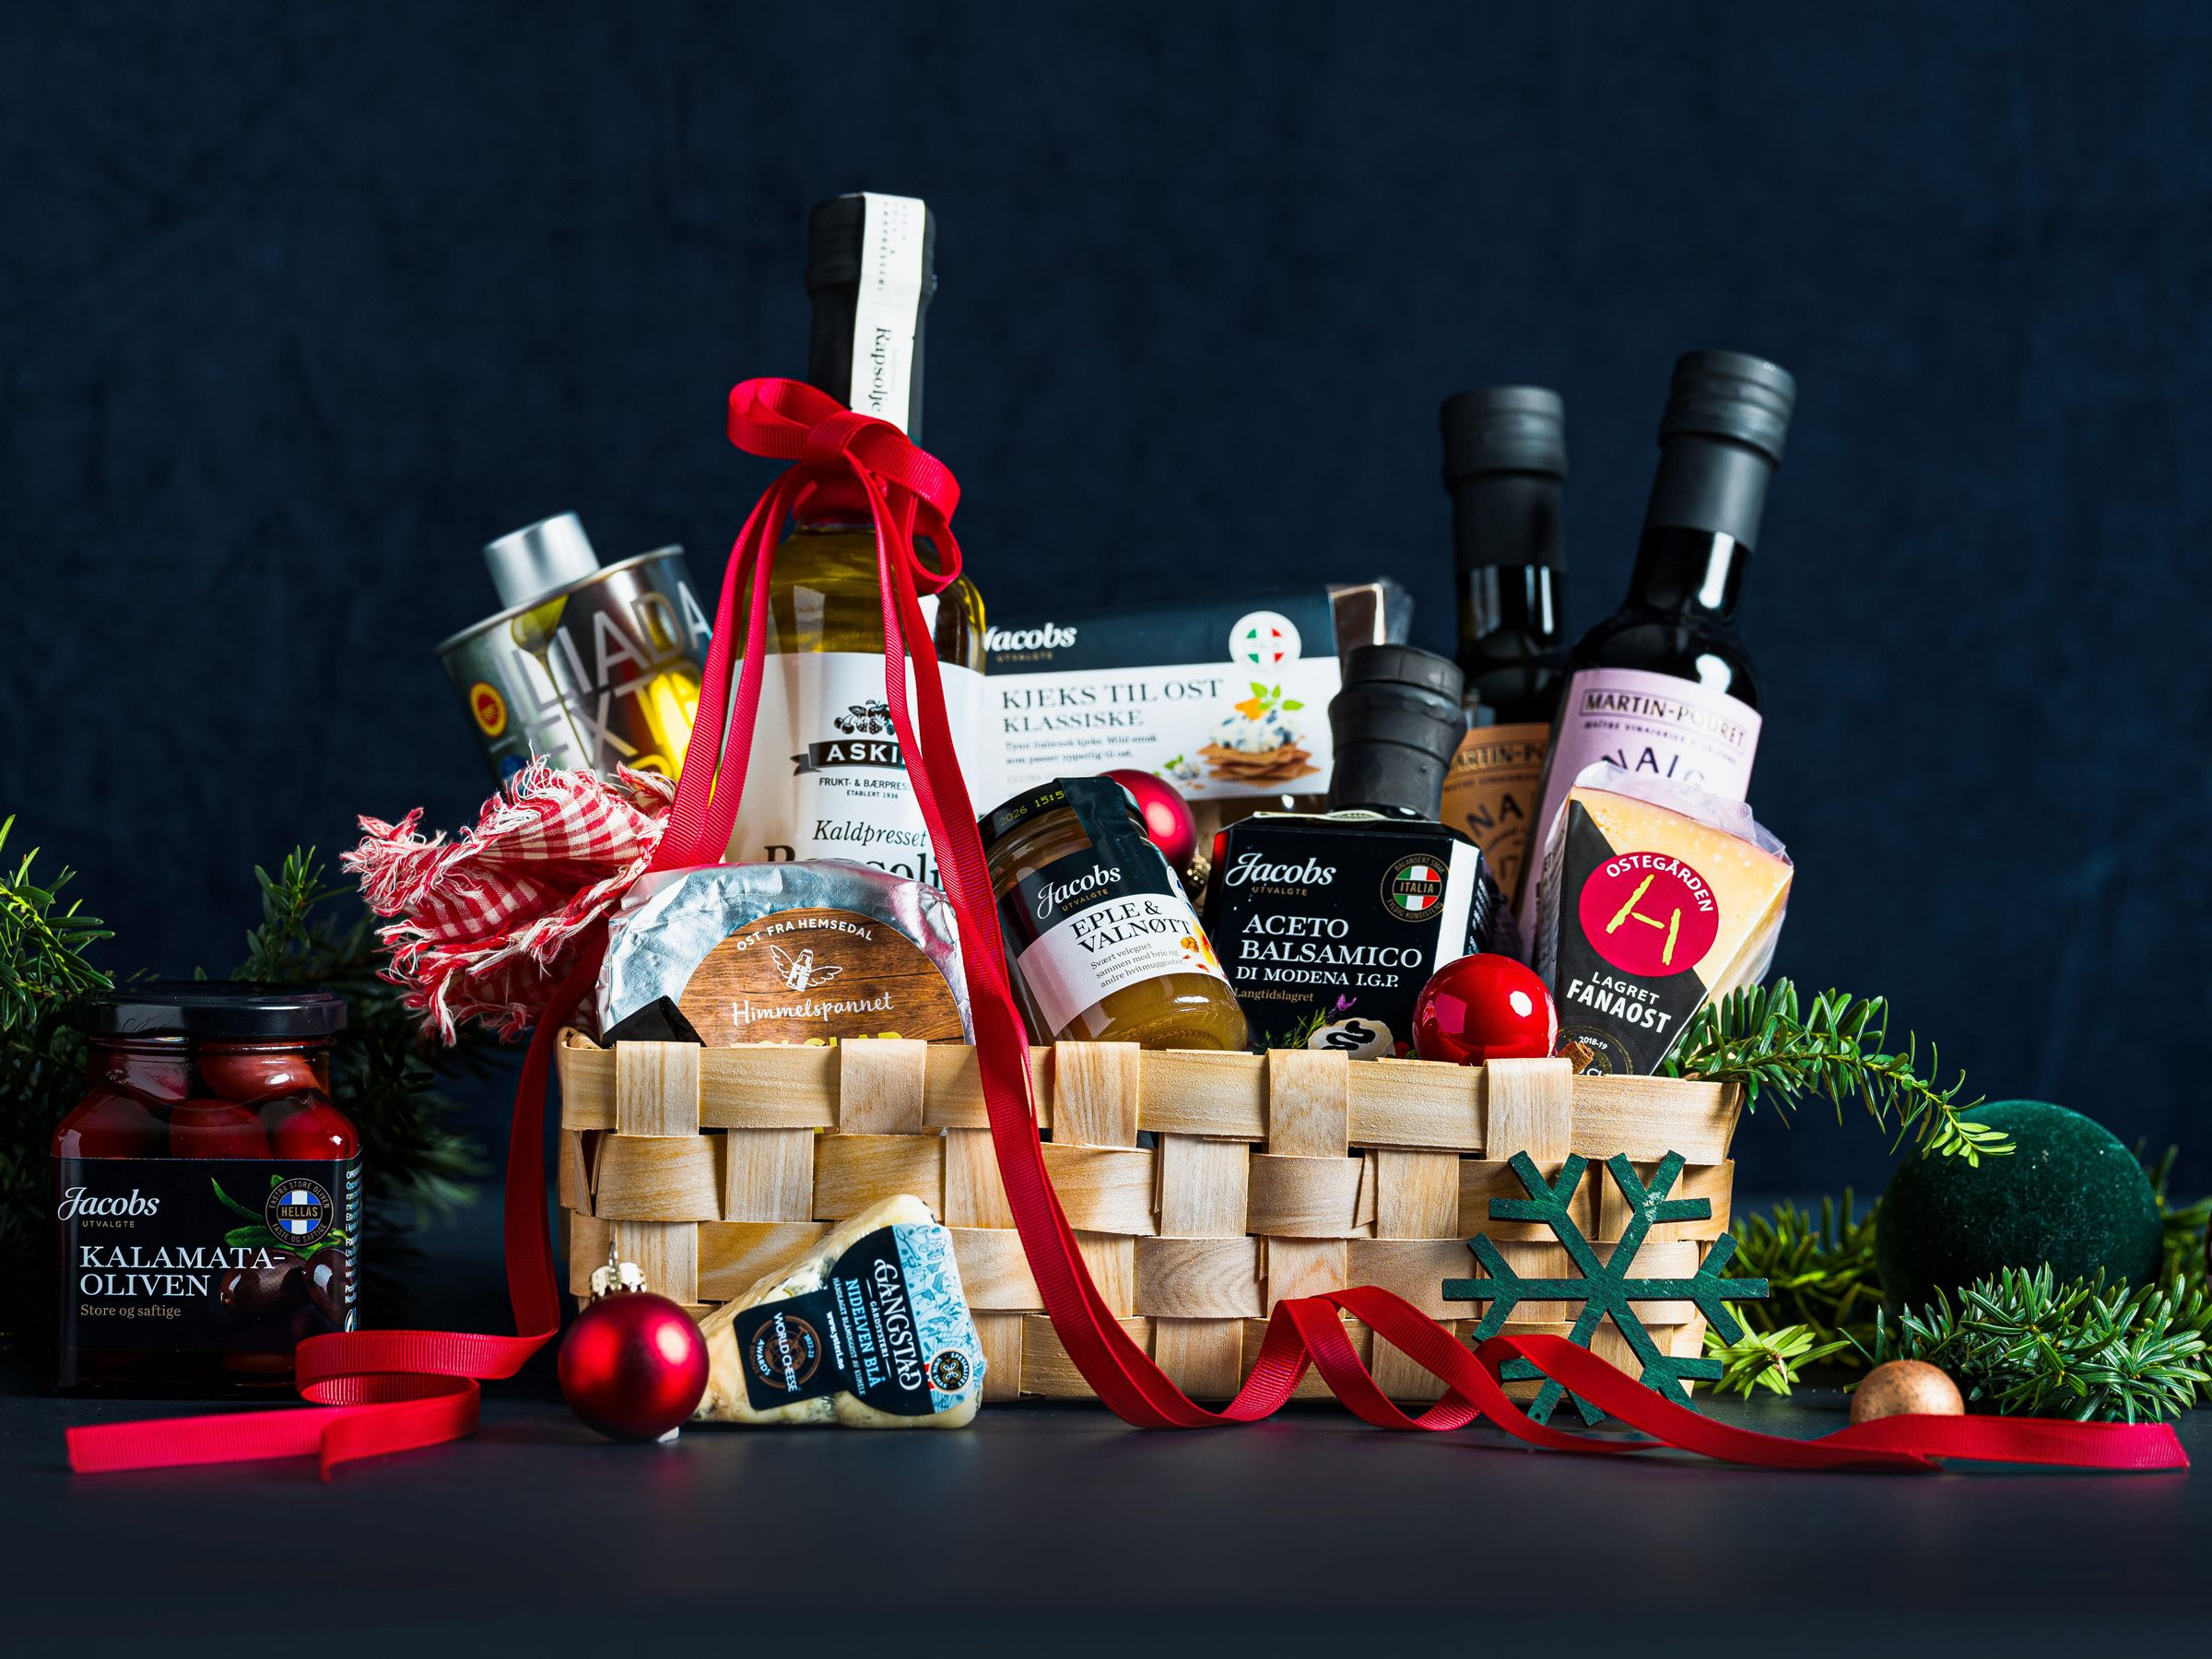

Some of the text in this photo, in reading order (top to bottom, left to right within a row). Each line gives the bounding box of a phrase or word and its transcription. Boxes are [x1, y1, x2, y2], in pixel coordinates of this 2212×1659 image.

[1002, 678, 1225, 711] KJEKS TIL OST
[1003, 710, 1145, 734] KLASSISKE
[826, 743, 906, 765] ASKI
[818, 777, 911, 791] FRUKT- & BÆRPRES
[846, 790, 880, 798] ETABLERT
[1000, 790, 1066, 827] 2026 15:5
[812, 819, 928, 848] Kaldpresset
[1225, 853, 1337, 887] Jacobs
[1394, 856, 1446, 875] BALANSERT SMAK
[1037, 864, 1122, 920] Jacobs
[1252, 886, 1309, 897] UTVALGTE
[1400, 881, 1434, 894] ITALIA
[1606, 854, 1714, 912] OSTEGÅRDEN
[1062, 888, 1110, 912] UTVALGTE
[736, 917, 874, 951] OST FRA HEMSEDAL
[1069, 900, 1163, 940] EPLE &
[1241, 913, 1349, 938] ACETO
[1077, 918, 1193, 955] VALNØTT
[1090, 942, 1153, 971] Svært velegnet
[1096, 949, 1180, 980] sammen med brie og
[1238, 939, 1423, 968] BALSAMICO
[1100, 971, 1125, 988] andre
[1235, 966, 1399, 988] DI MODENA I.G.P.
[1591, 971, 1660, 1005] LAGRET
[731, 991, 895, 1027] Himmelspannet
[1233, 986, 1314, 1004] Langtidslagret
[1566, 978, 1672, 1034] FANAOST
[1578, 1035, 1608, 1051] 2018-19
[57, 1186, 160, 1221] Jacobs
[268, 1181, 331, 1209] EKSTRA STORE OLIVEN
[82, 1220, 135, 1229] UTVALGTE
[281, 1206, 318, 1218] HELLAS
[272, 1223, 327, 1243] FASTE OG SAFTIGE
[79, 1245, 286, 1269] KALAMATA-
[79, 1273, 211, 1297] OLIVEN
[80, 1303, 182, 1319] Store og saftige
[874, 1258, 922, 1391] GANGSTAD
[826, 1311, 845, 1371] www.ysteri.no
[845, 1277, 887, 1388] NIDELVEN BLÅ
[869, 1300, 889, 1358] GÅRDSYSTERI
[756, 1338, 771, 1376] AWARDS
[773, 1312, 798, 1393] WORLD CHEESE
